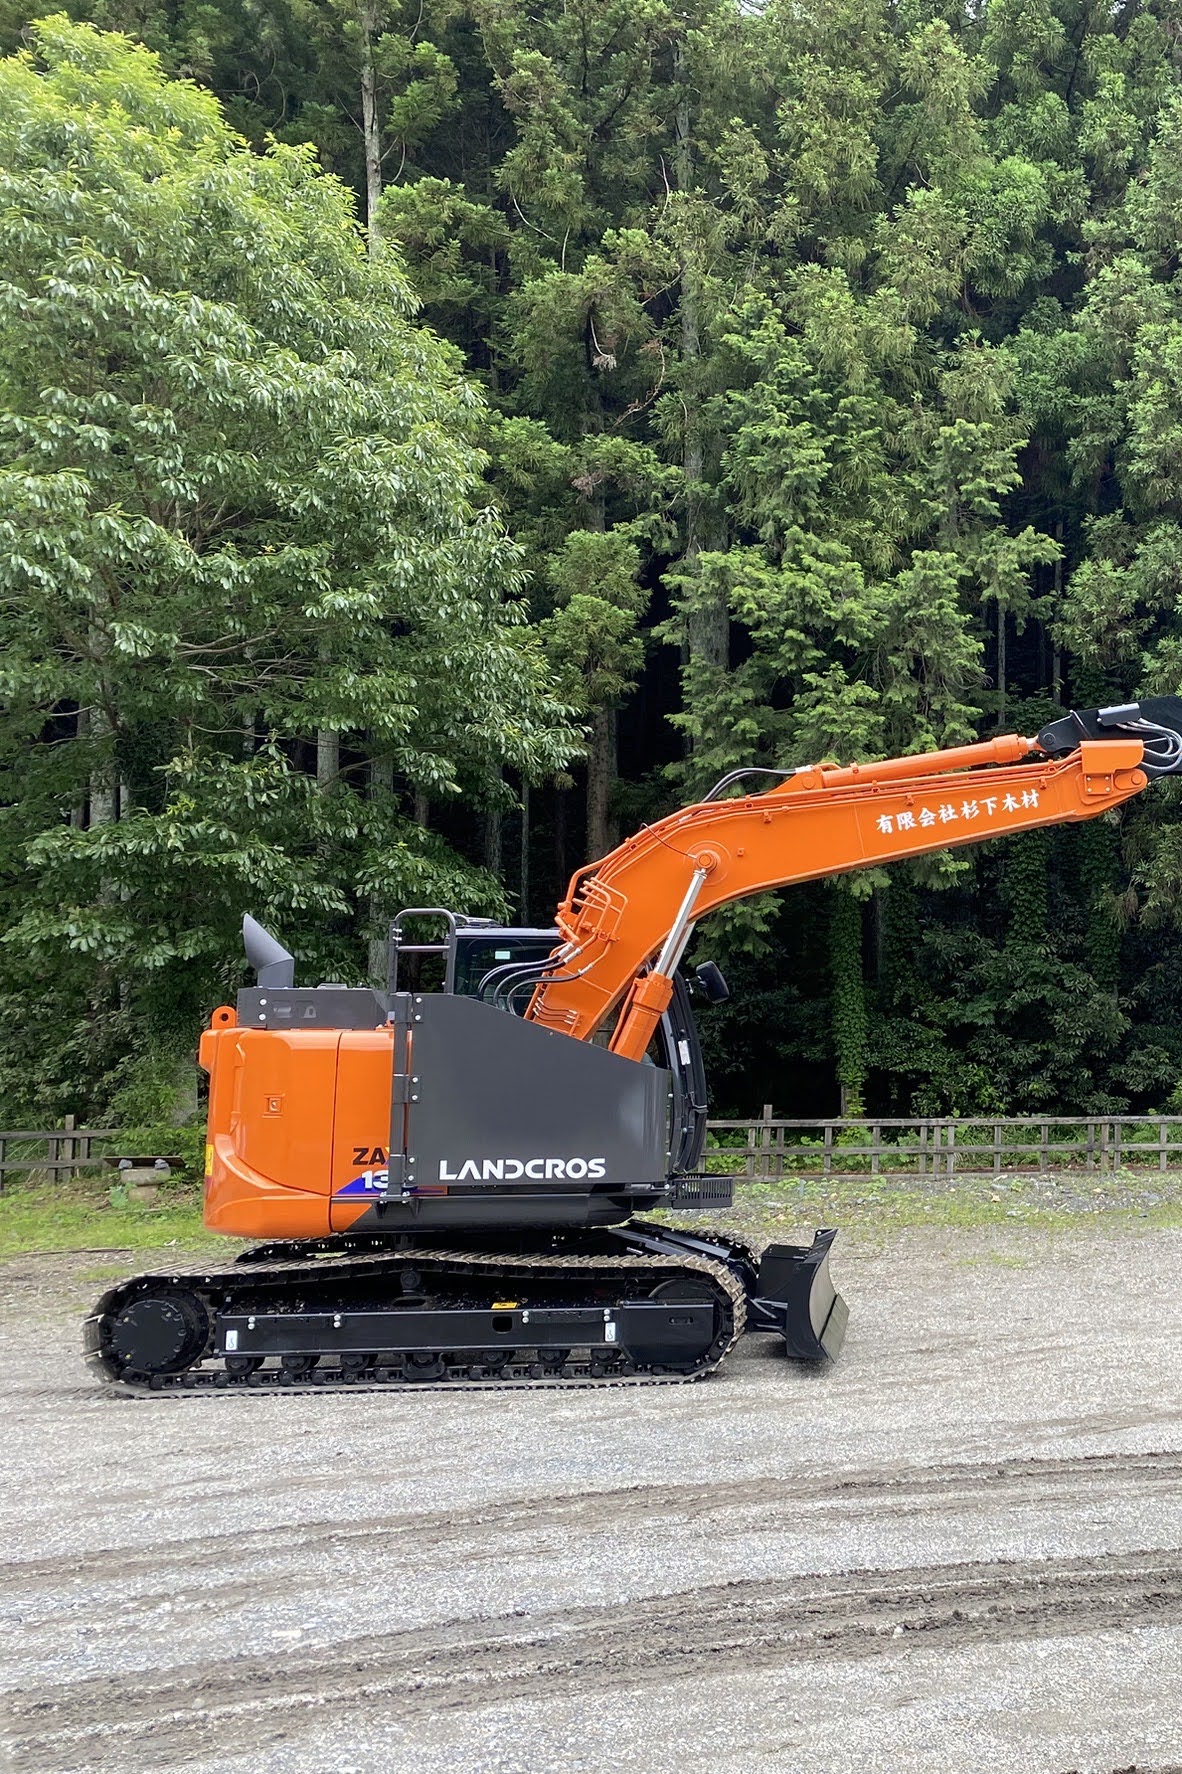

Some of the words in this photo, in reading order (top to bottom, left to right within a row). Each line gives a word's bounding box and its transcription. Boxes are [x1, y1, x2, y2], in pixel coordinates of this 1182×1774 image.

[876, 789, 1040, 834] 有限会社杉下木材
[439, 1158, 606, 1180] LANDCROS
